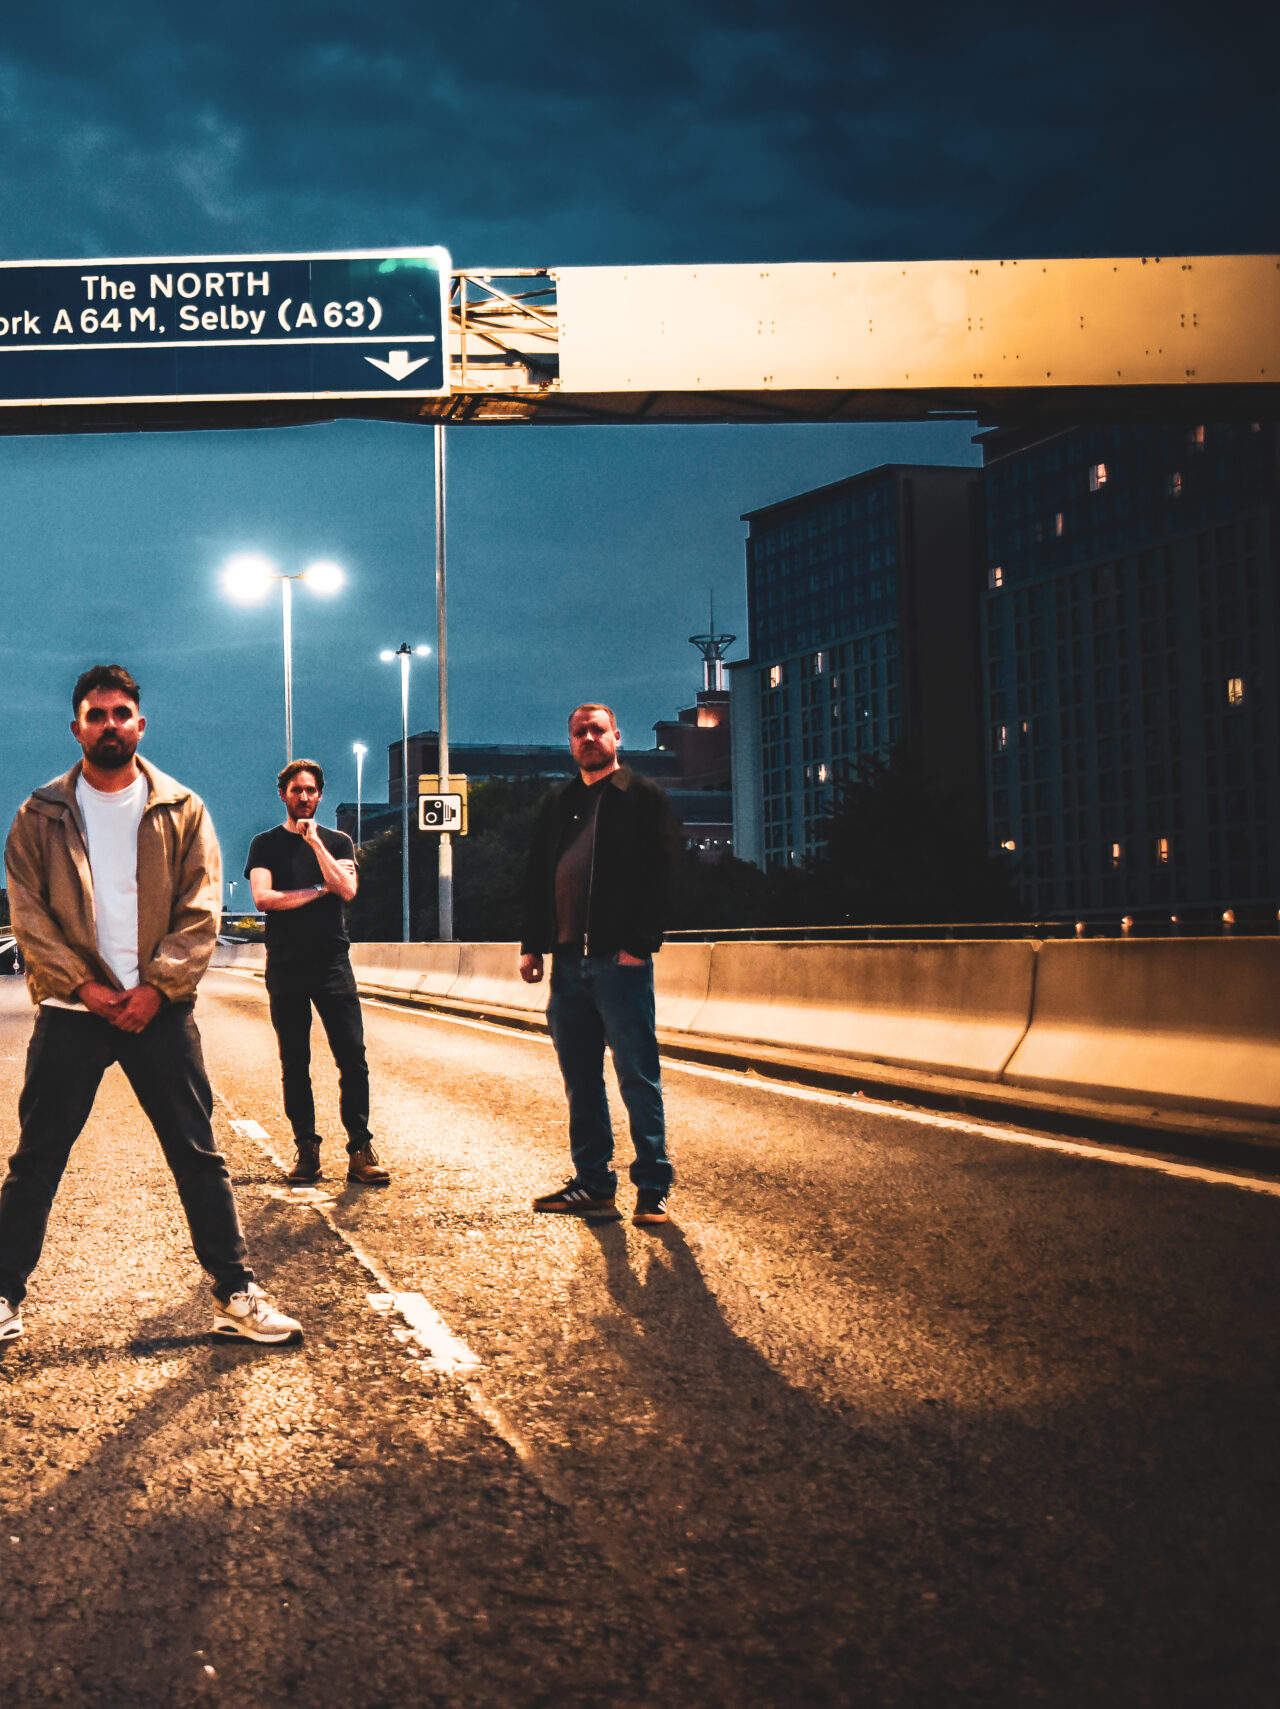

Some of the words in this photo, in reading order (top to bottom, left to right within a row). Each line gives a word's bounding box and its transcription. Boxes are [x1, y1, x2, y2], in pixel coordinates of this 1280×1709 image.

[80, 275, 136, 301] The
[149, 271, 270, 299] NORTH
[179, 304, 267, 335] Selby
